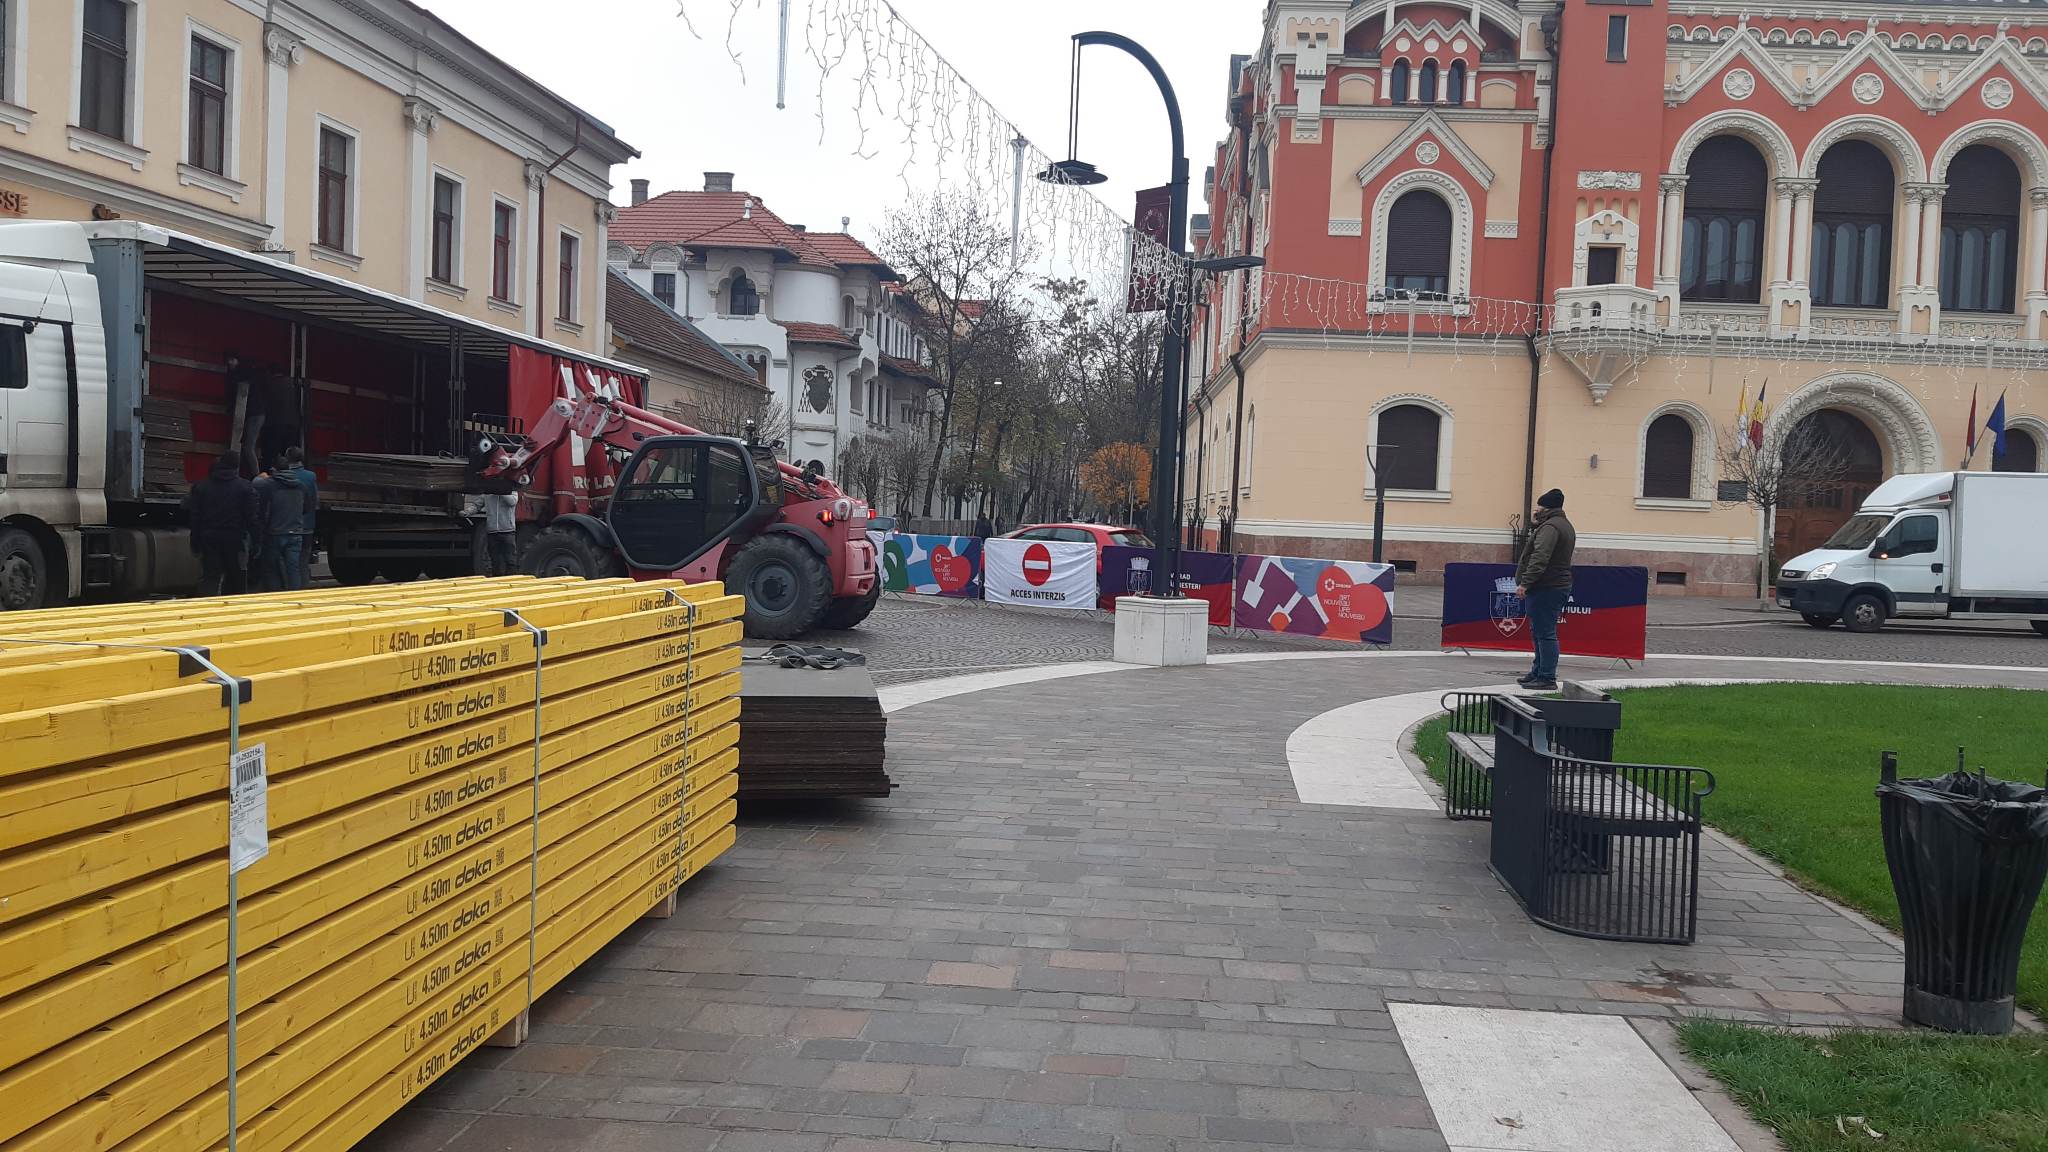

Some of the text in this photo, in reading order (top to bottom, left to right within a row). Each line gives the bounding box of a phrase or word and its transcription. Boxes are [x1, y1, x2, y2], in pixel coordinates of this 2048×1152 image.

[1010, 589, 1066, 601] ACCES INTERZIS
[389, 632, 419, 653] 4.50m
[423, 626, 463, 648] doka
[427, 655, 456, 680] 4.50m
[459, 648, 497, 672] doka
[423, 700, 452, 725] 4.50m
[456, 691, 494, 716] doka
[424, 744, 453, 769] 4.50m
[456, 733, 494, 759] doka
[424, 789, 453, 815] 4.50m
[456, 774, 494, 802] doka
[423, 833, 452, 860] 4.50m
[455, 816, 493, 846] doka
[422, 877, 451, 906] 4.50m
[454, 858, 492, 889] doka
[419, 923, 449, 952] 4.50m
[452, 899, 490, 933] doka
[421, 965, 450, 995] 4.50m
[454, 939, 491, 975] doka
[419, 1010, 448, 1041] 4.50m
[451, 982, 489, 1019] doka
[416, 1054, 446, 1086] 4.50m
[449, 1021, 487, 1062] doka
